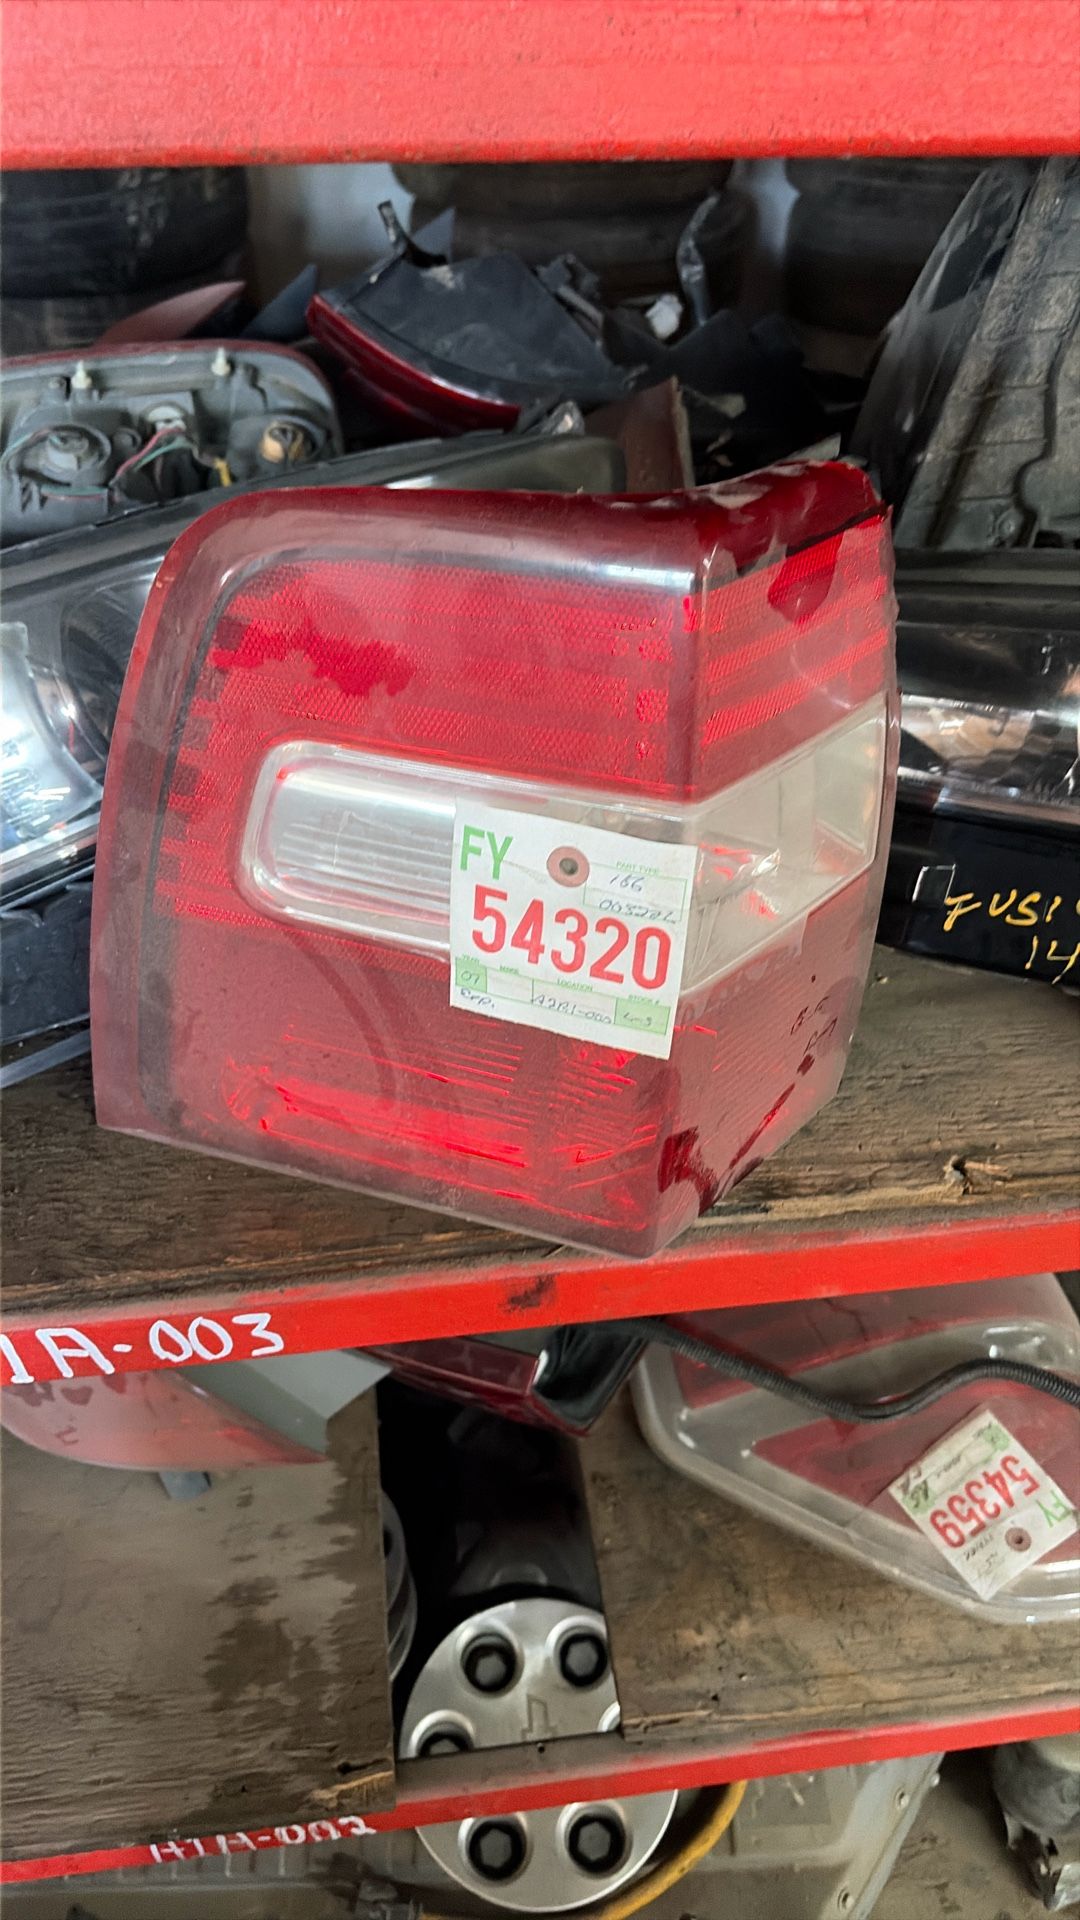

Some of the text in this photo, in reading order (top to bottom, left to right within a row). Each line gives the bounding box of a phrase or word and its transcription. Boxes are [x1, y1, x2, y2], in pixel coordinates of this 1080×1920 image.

[460, 825, 514, 880] FY
[943, 889, 1080, 932] FUSI
[471, 884, 671, 990] 54320
[556, 978, 594, 992] LOCATION
[929, 1454, 1041, 1549] 54359
[1034, 1489, 1075, 1529] FY
